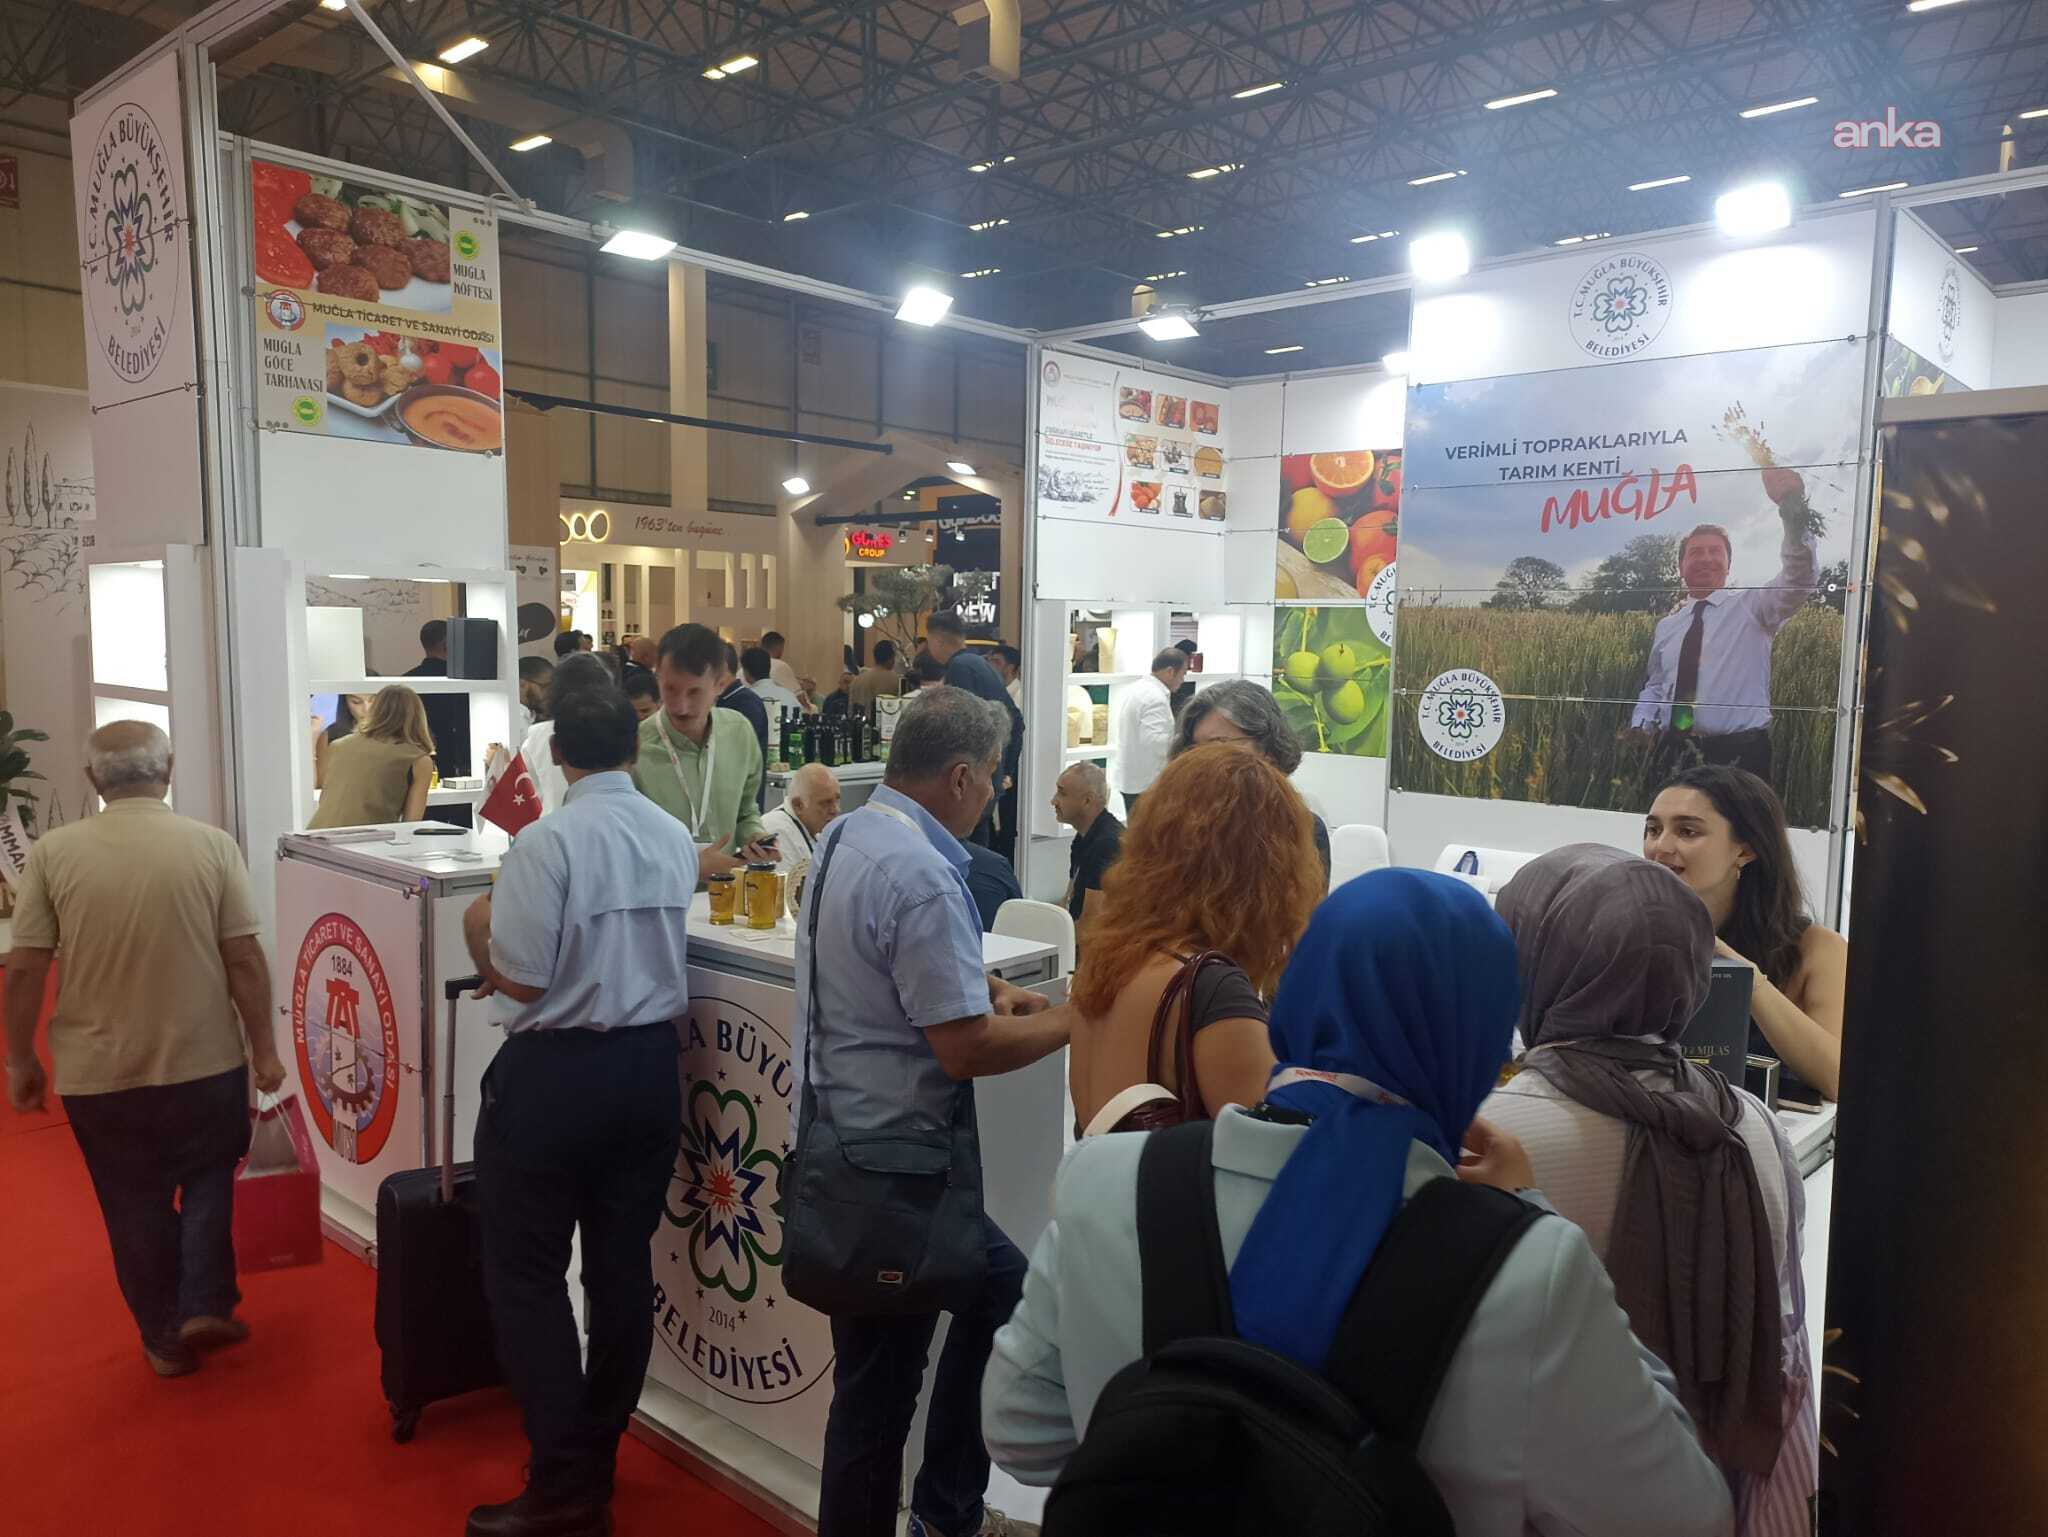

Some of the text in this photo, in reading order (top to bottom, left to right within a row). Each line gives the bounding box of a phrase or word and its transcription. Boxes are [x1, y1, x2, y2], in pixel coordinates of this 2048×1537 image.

[356, 307, 402, 327] TİCARET
[405, 318, 423, 330] VE
[422, 321, 461, 338] SANAYİ
[1586, 332, 1650, 356] BELEDİYESİ
[265, 373, 324, 393] TARHANASI
[1445, 428, 1688, 460] VERİMLİ TOPRAKLARIYLA
[1498, 456, 1621, 481] TARIM KENTİ
[1540, 463, 1697, 533] MUĞLA
[1433, 741, 1487, 759] BELEDİYESİ
[331, 955, 352, 977] 1884
[304, 922, 338, 965] TİCARET
[339, 923, 353, 944] VE
[383, 1011, 395, 1088] ODASI
[709, 1306, 736, 1332] 2014
[651, 1282, 803, 1390] BELEDİYESİ
